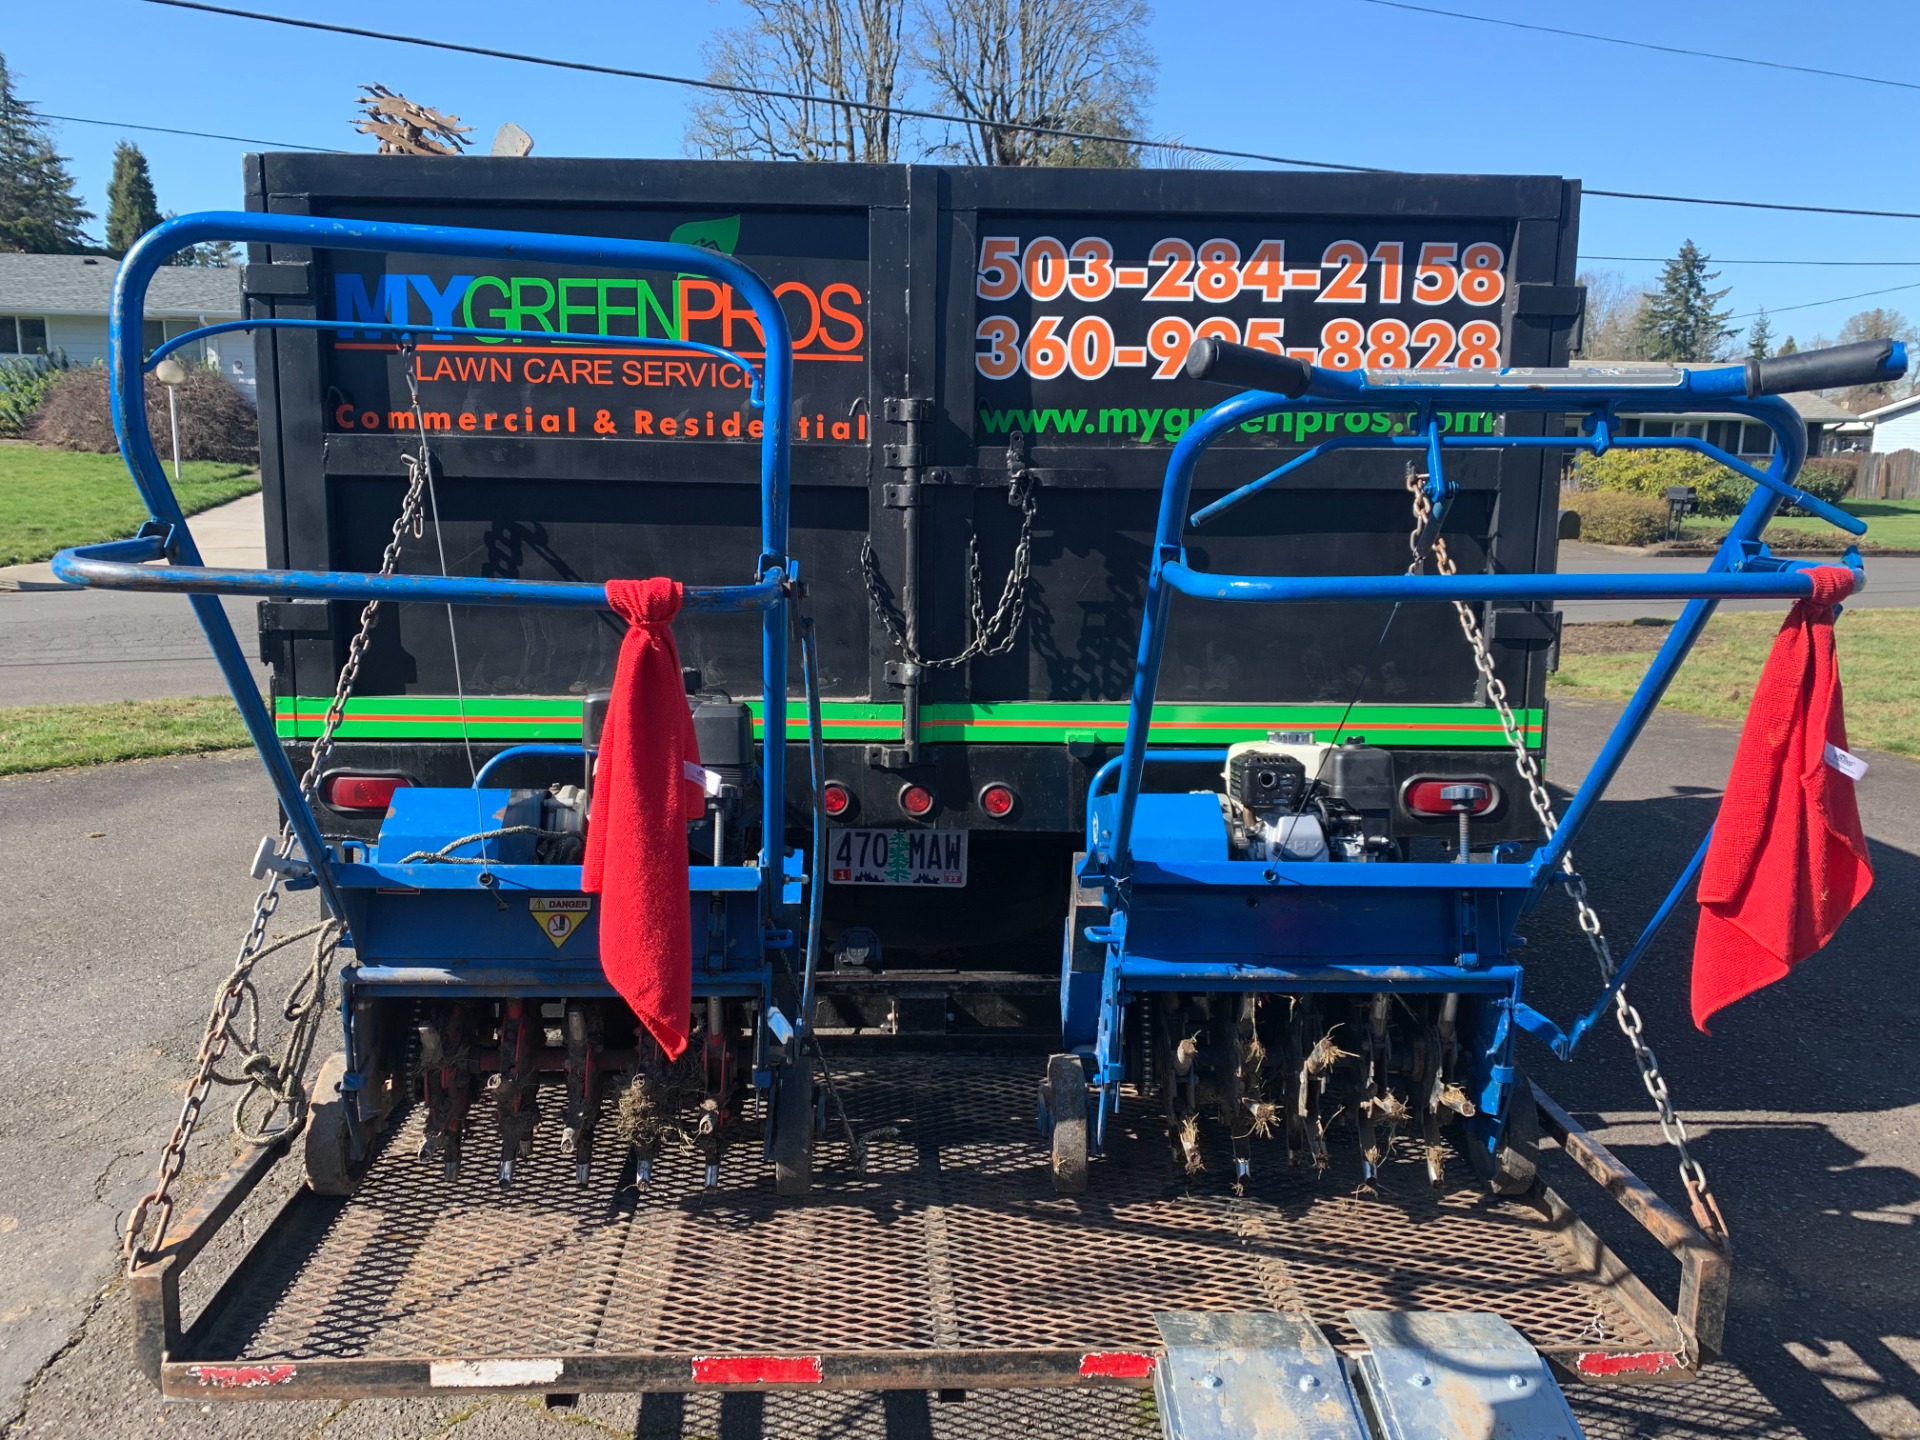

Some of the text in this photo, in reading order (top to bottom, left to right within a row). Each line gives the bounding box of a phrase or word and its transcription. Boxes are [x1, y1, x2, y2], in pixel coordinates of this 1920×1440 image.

[976, 236, 1504, 306] 503-284-2158
[334, 273, 863, 350] MYGREENPROS
[415, 356, 512, 383] LAWN
[523, 358, 613, 385] CARE
[335, 404, 867, 440] Commercial & Residetial
[979, 408, 1493, 443] www.mygenpros.om
[836, 832, 961, 870] 470 MAW
